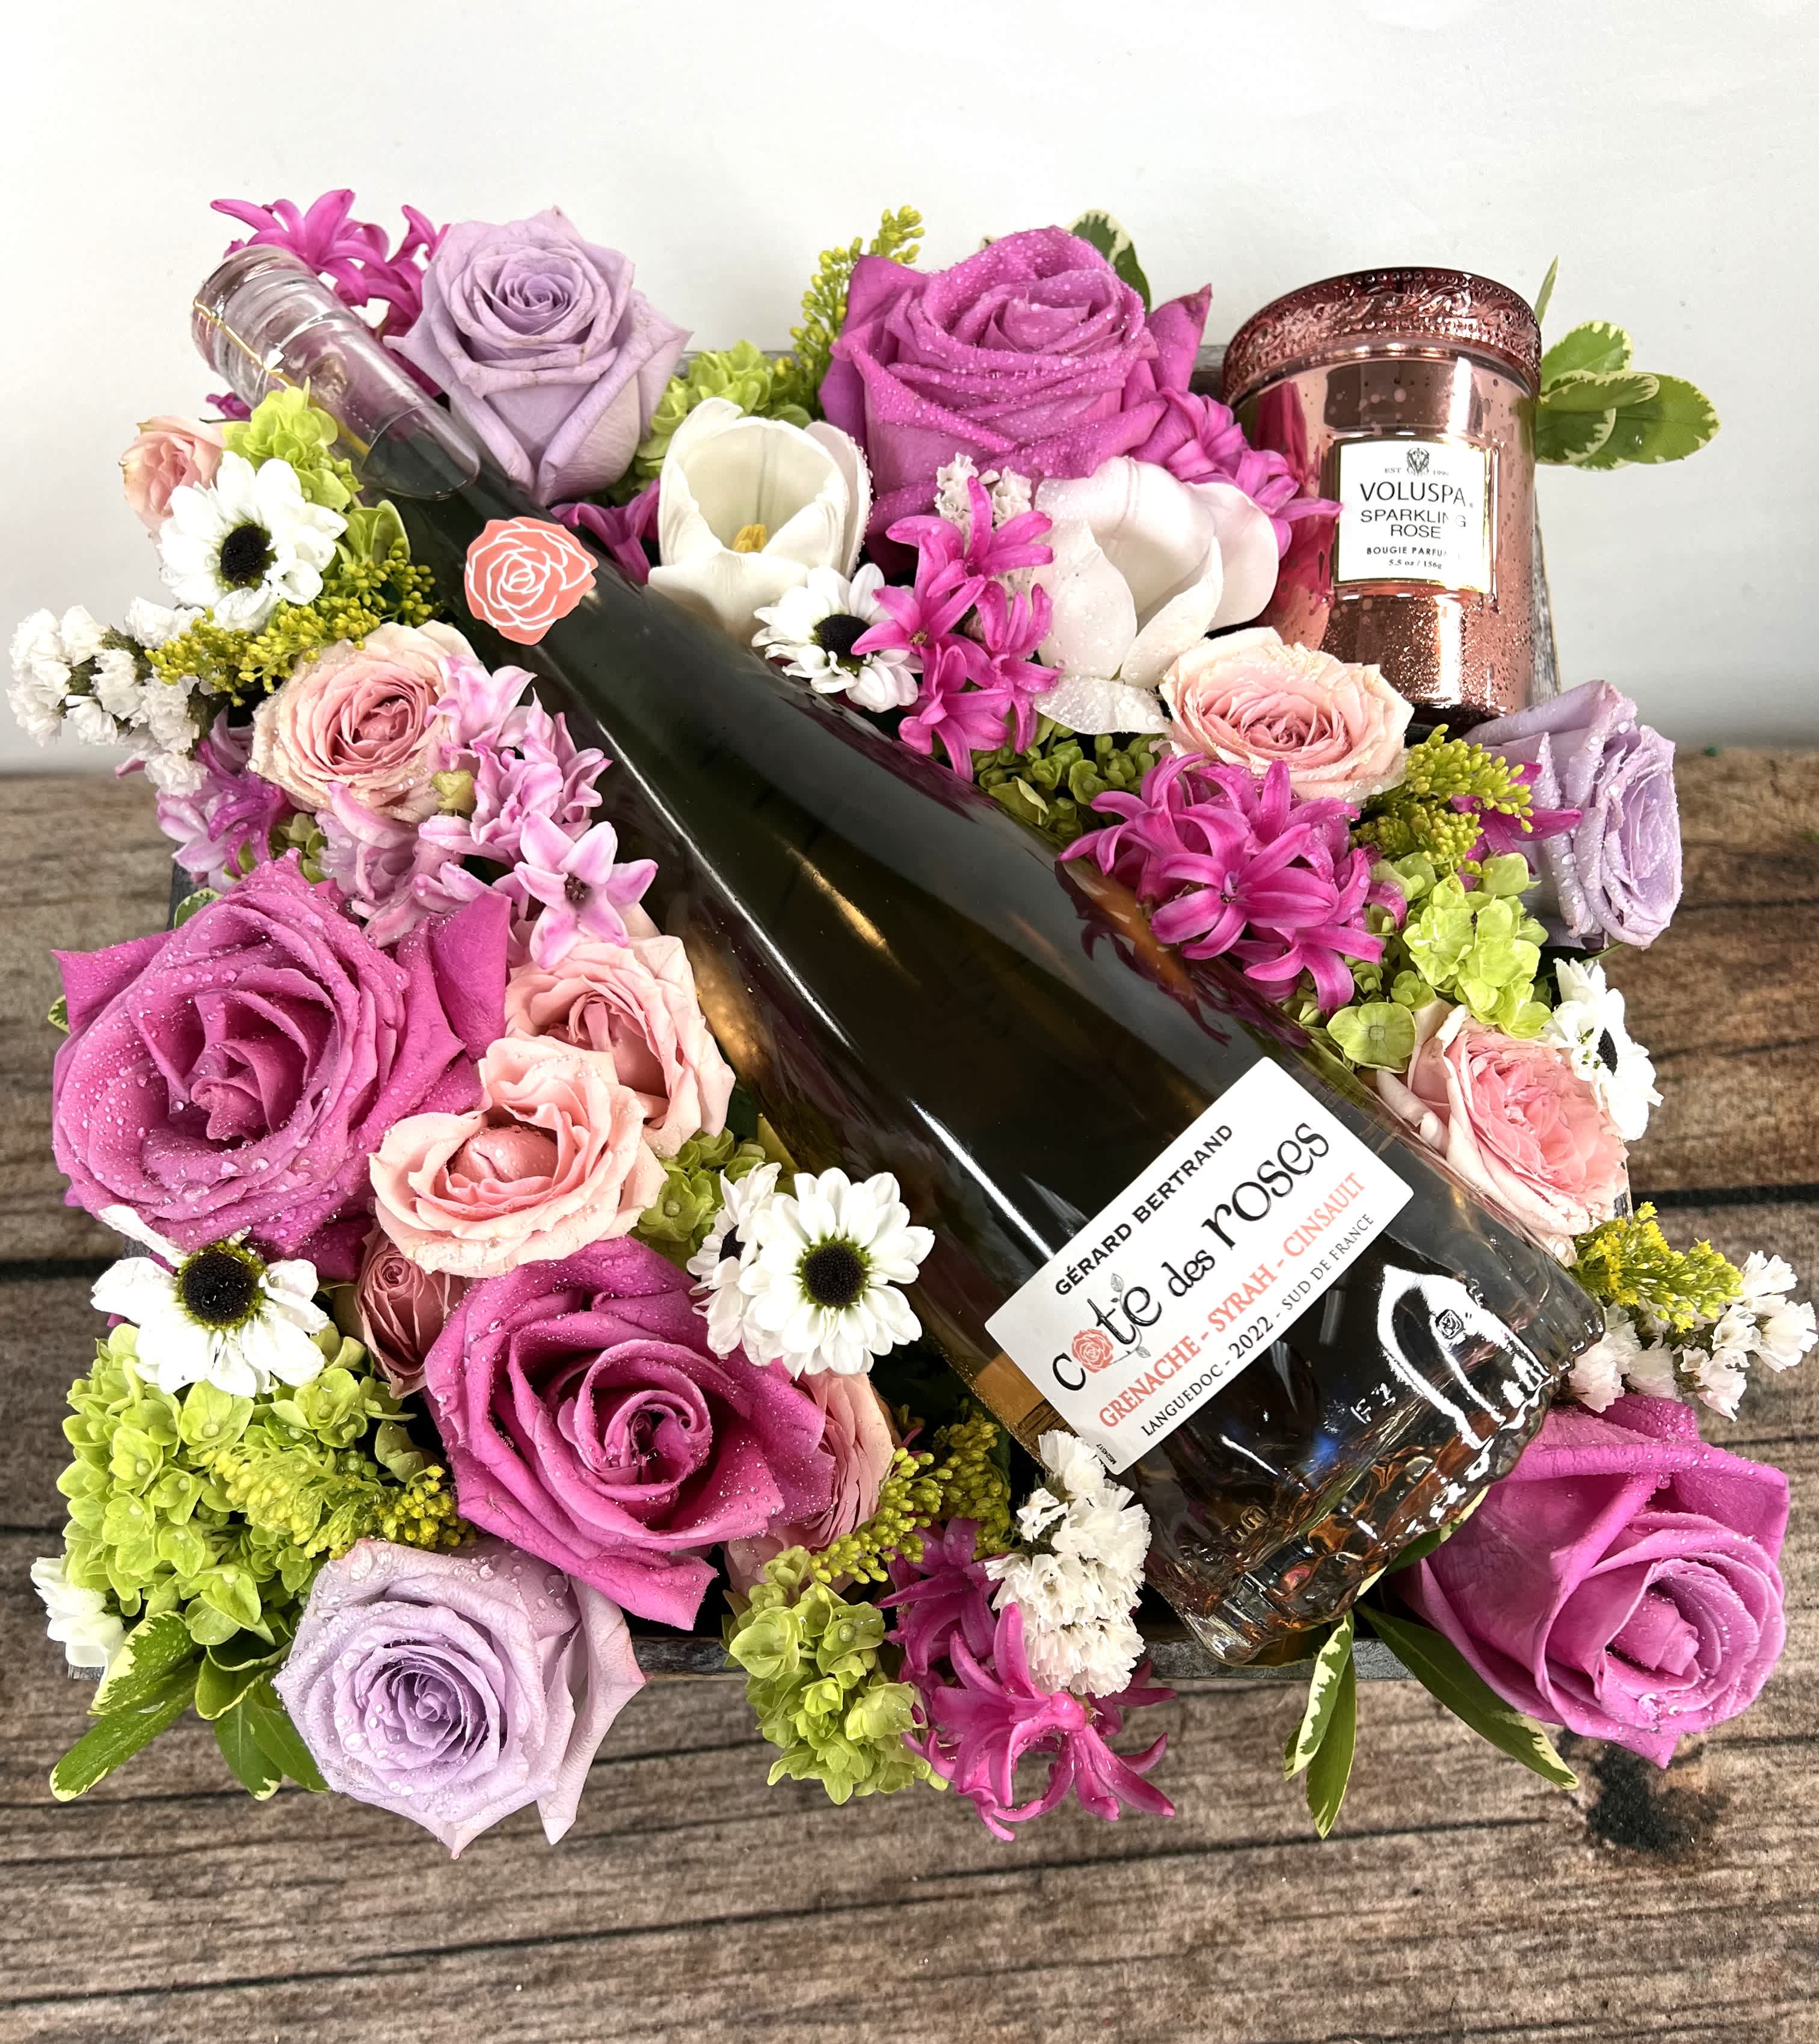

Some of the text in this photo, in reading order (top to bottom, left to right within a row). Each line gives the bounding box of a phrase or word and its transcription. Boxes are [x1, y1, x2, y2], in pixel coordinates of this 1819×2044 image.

[1359, 481, 1466, 507] VOLUSPA
[1390, 524, 1441, 539] ROSE
[1367, 546, 1407, 555] BOUGIE
[1424, 560, 1442, 569] 156g
[1056, 1125, 1233, 1295] GÉRARD BERTRAND
[1161, 1249, 1215, 1297] des
[1201, 1122, 1329, 1250] roses
[1099, 1335, 1201, 1427] GRENACHE
[1207, 1263, 1278, 1333] SYRAH
[1282, 1171, 1365, 1257] CINSAULT
[1140, 1364, 1223, 1436] LANGUEDOC
[1228, 1316, 1274, 1359] 2022
[1282, 1280, 1311, 1311] SUD
[1310, 1259, 1332, 1280] DE
[1328, 1213, 1374, 1261] FRANCE
